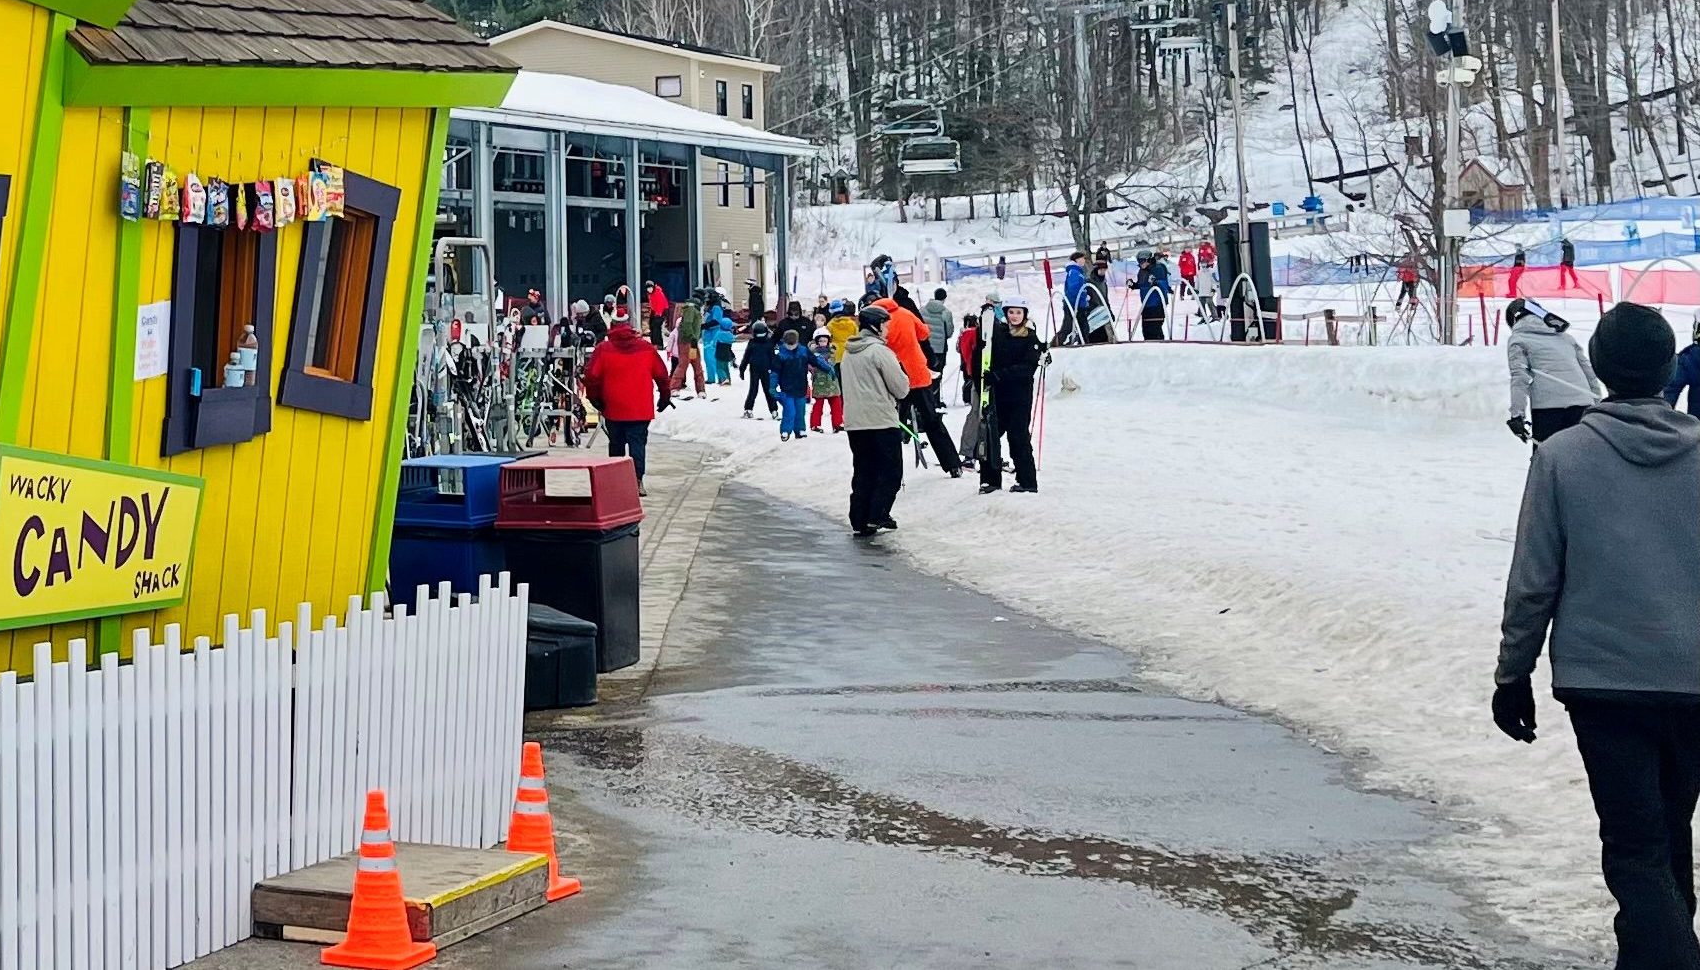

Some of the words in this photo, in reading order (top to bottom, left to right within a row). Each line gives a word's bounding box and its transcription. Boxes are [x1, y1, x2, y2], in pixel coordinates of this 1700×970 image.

[10, 473, 72, 504] WACKY
[13, 486, 170, 598] CANDY
[133, 563, 182, 599] SHACK
